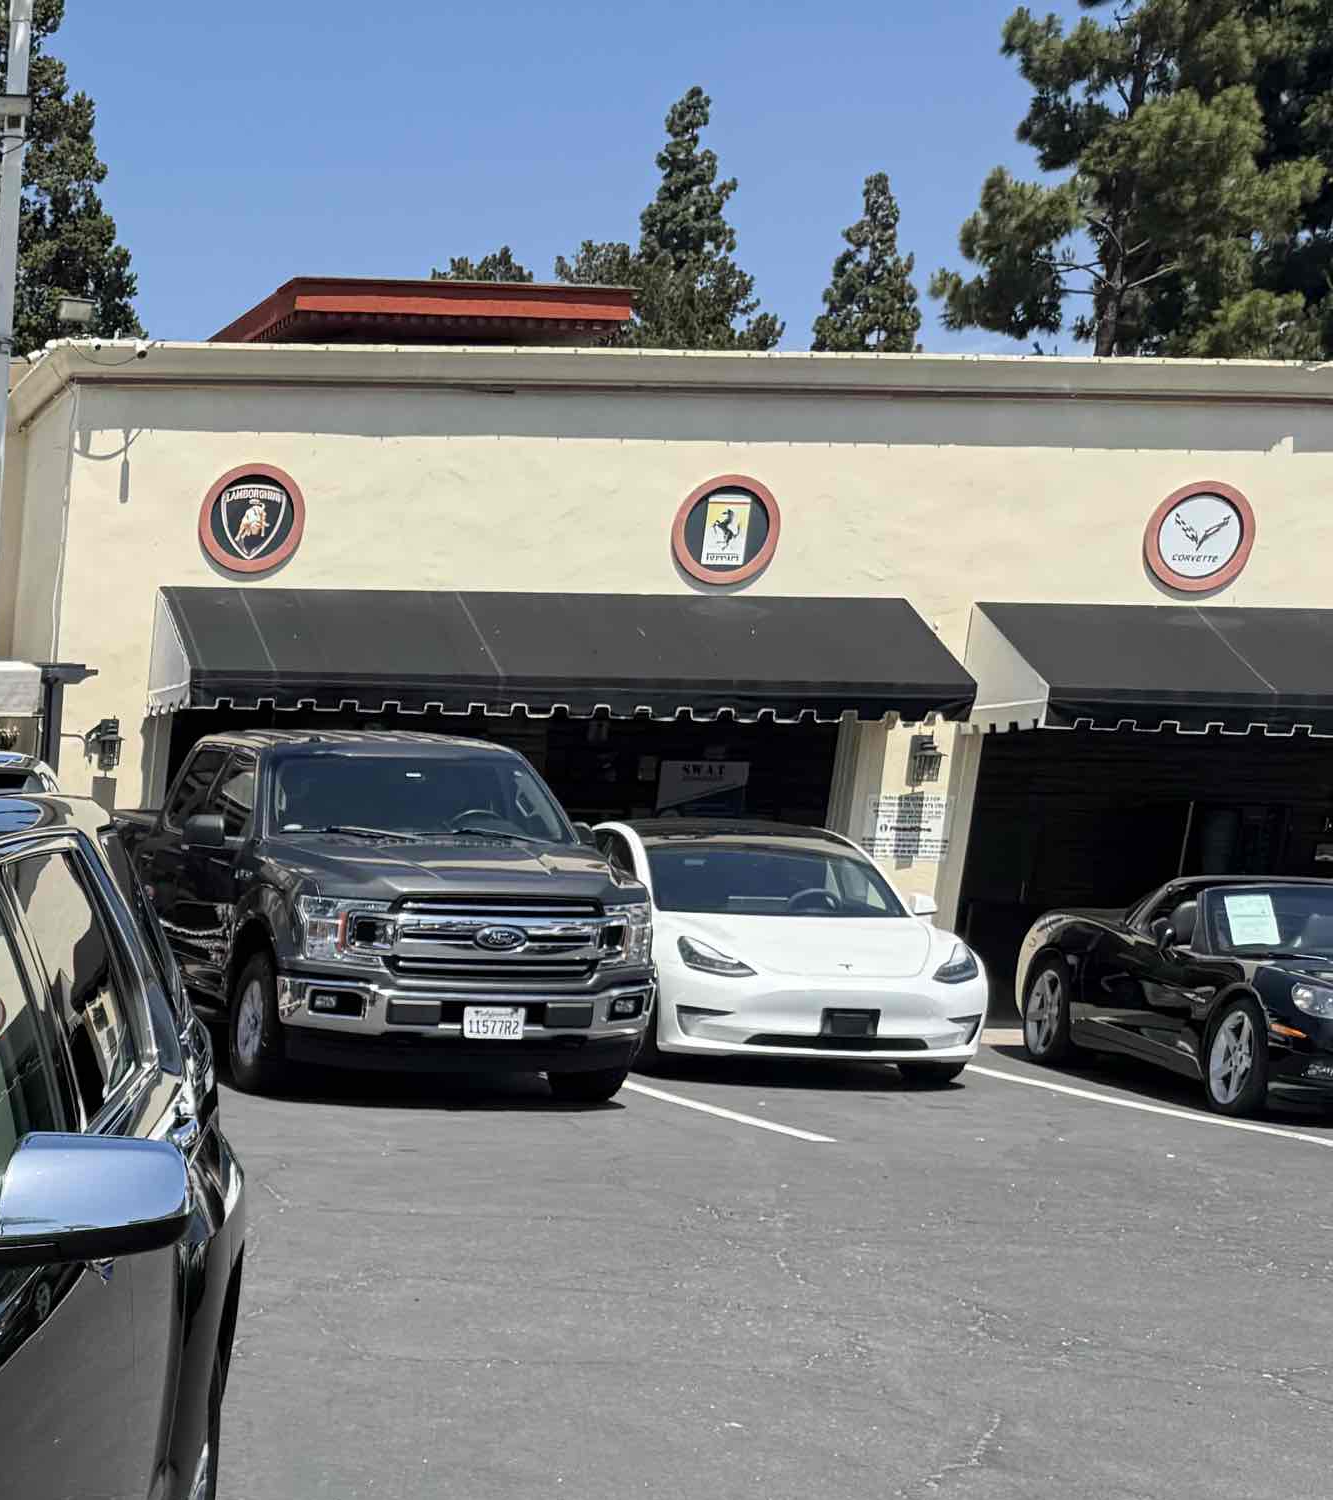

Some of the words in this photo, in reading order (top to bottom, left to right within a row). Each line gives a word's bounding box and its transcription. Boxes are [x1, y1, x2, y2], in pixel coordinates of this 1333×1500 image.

[225, 487, 282, 503] LAMBORGHINI
[1171, 553, 1219, 563] CORVETTE
[468, 1019, 520, 1036] 11577R2
